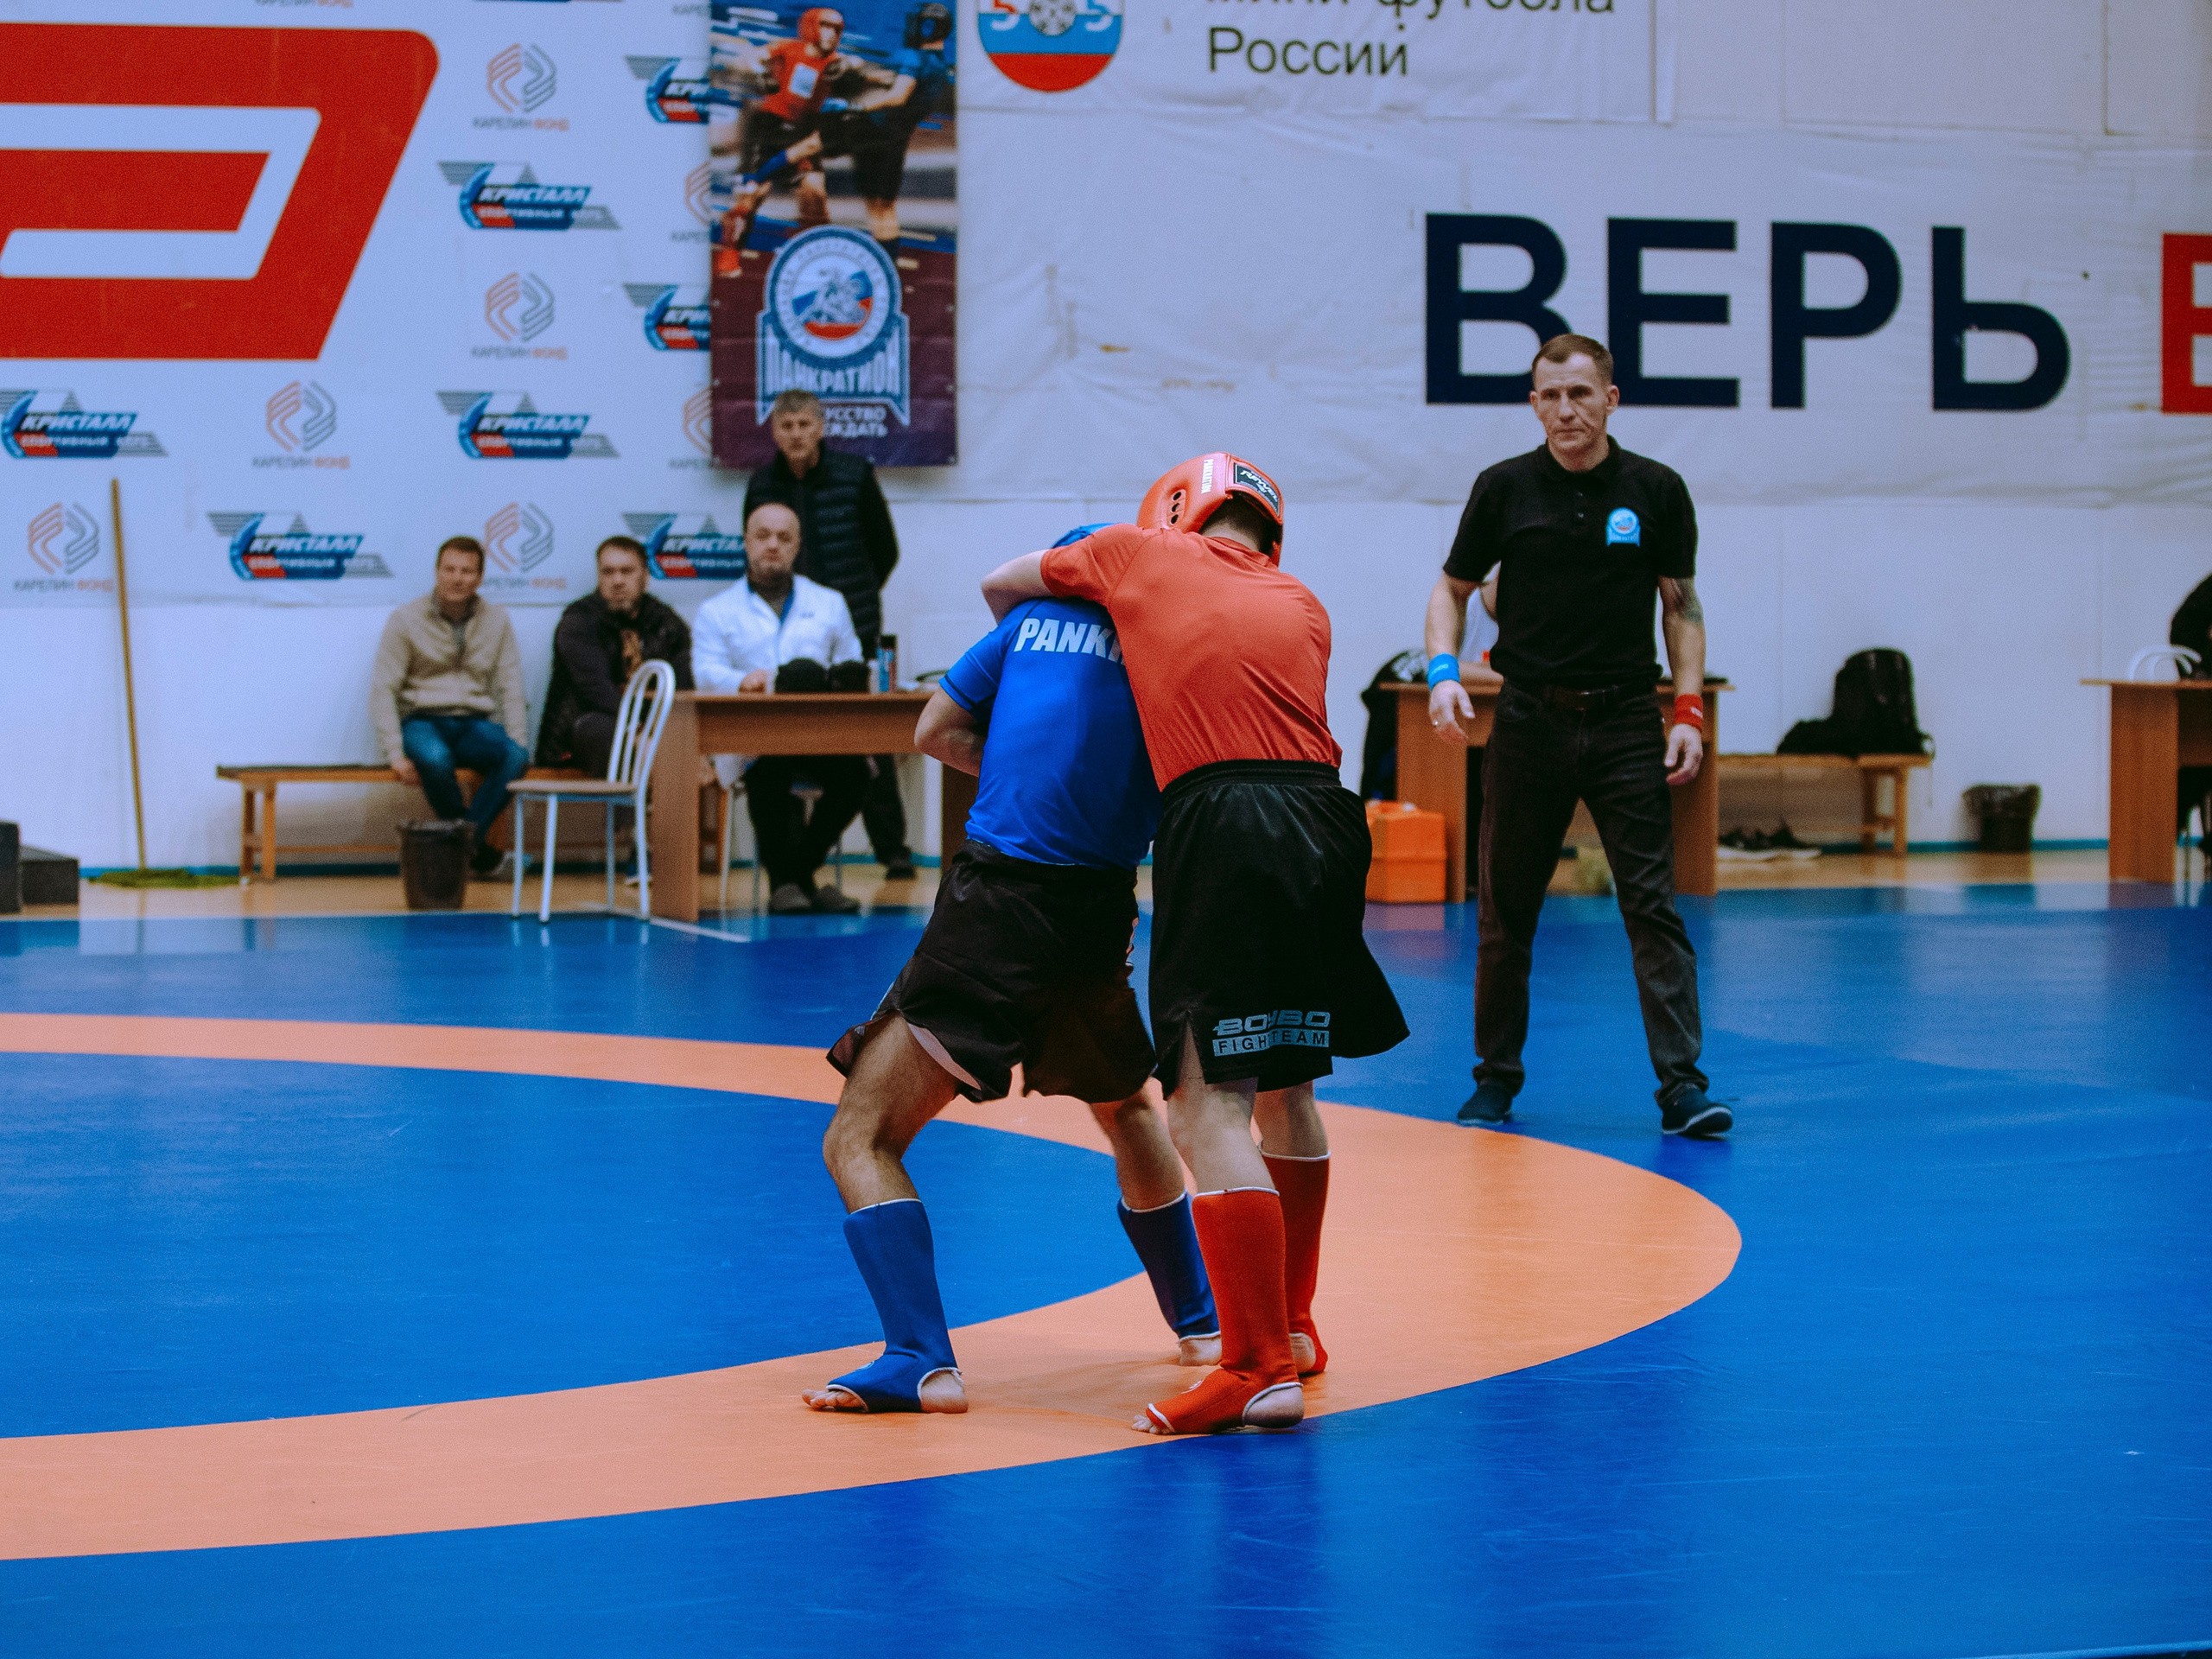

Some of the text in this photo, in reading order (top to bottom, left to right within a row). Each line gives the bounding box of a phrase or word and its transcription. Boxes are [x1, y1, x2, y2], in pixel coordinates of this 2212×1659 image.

[1425, 213, 2071, 413] ВЕРЬ
[824, 407, 887, 421] УССТВО
[661, 537, 744, 552] КРИСТА
